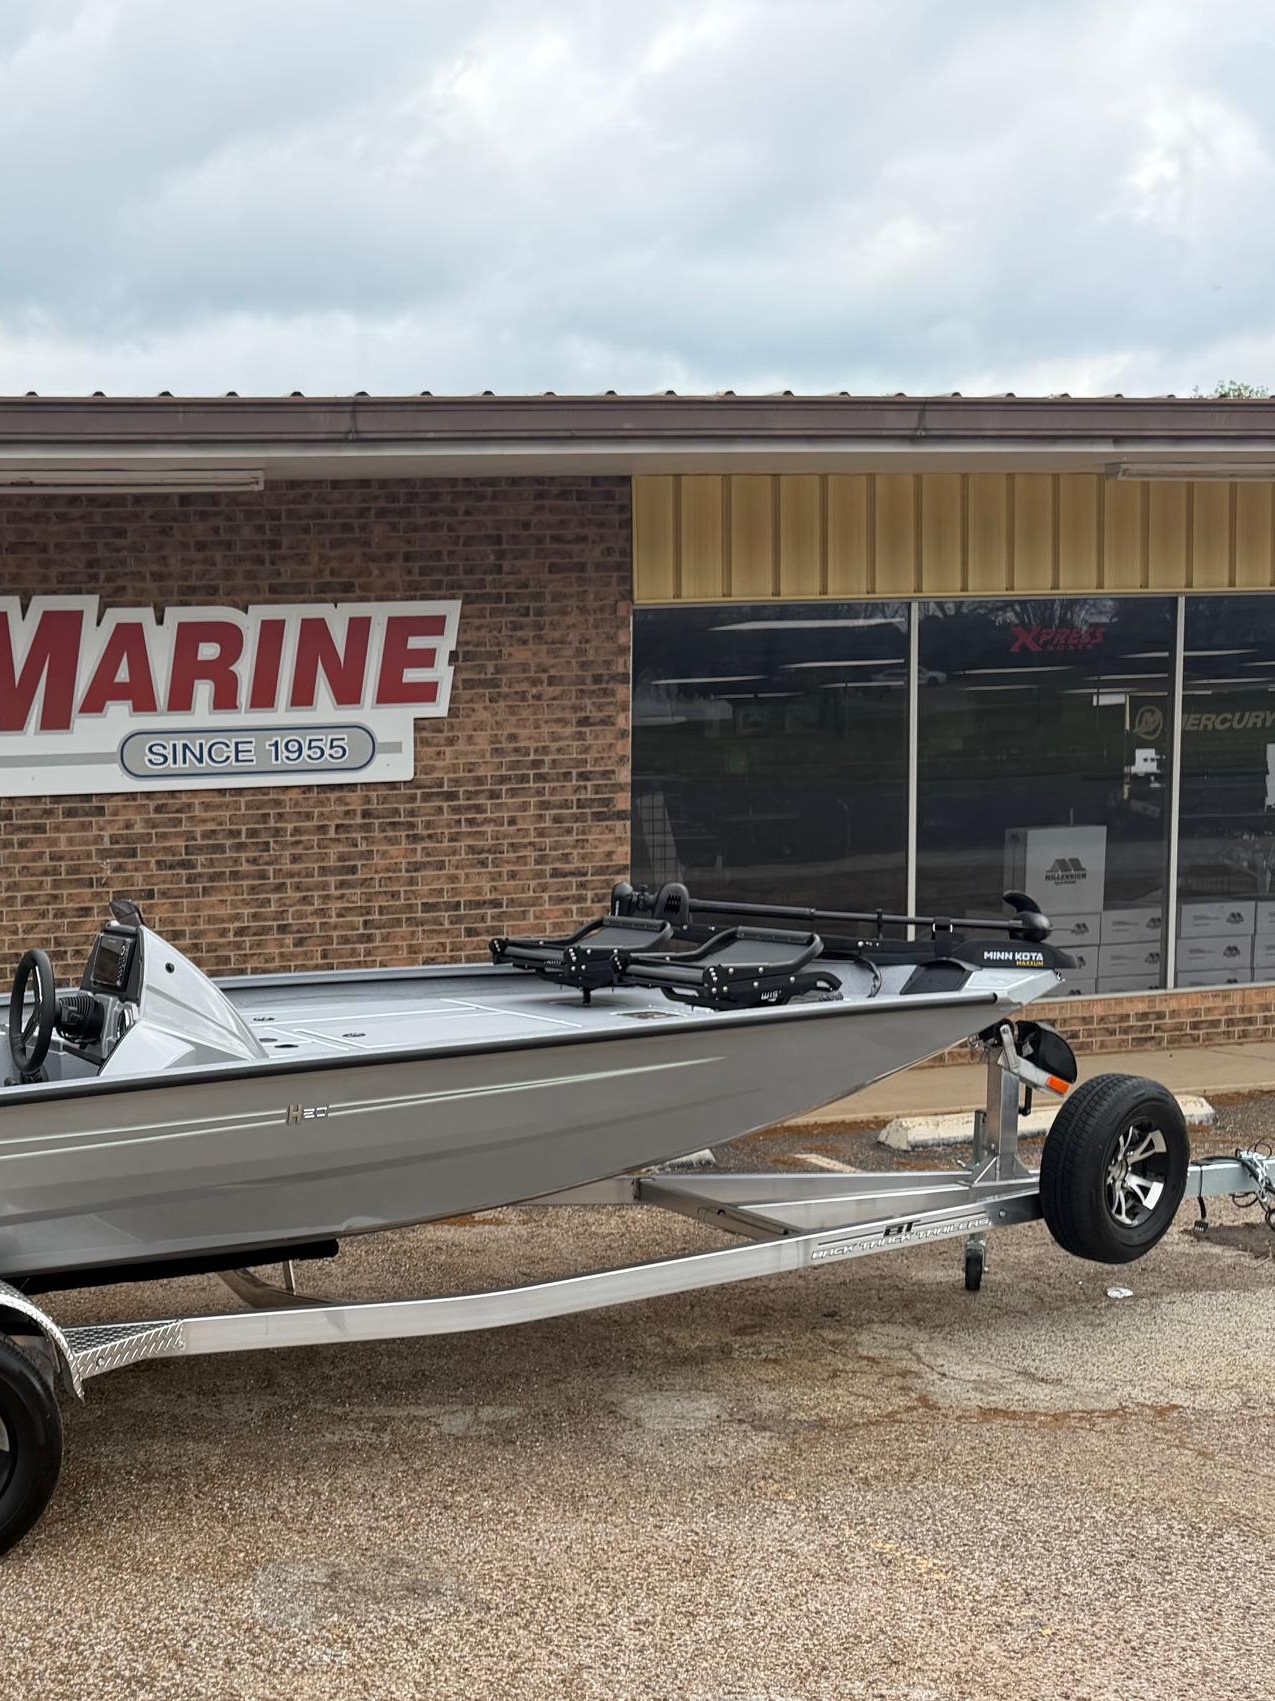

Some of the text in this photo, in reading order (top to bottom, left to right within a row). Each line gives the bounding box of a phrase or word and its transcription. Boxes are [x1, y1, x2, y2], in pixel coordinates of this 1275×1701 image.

[1010, 625, 1106, 652] XPRESS
[1181, 710, 1275, 731] ERCURY
[146, 736, 348, 767] SINCE 1955
[983, 950, 1044, 961] MINN KOTA
